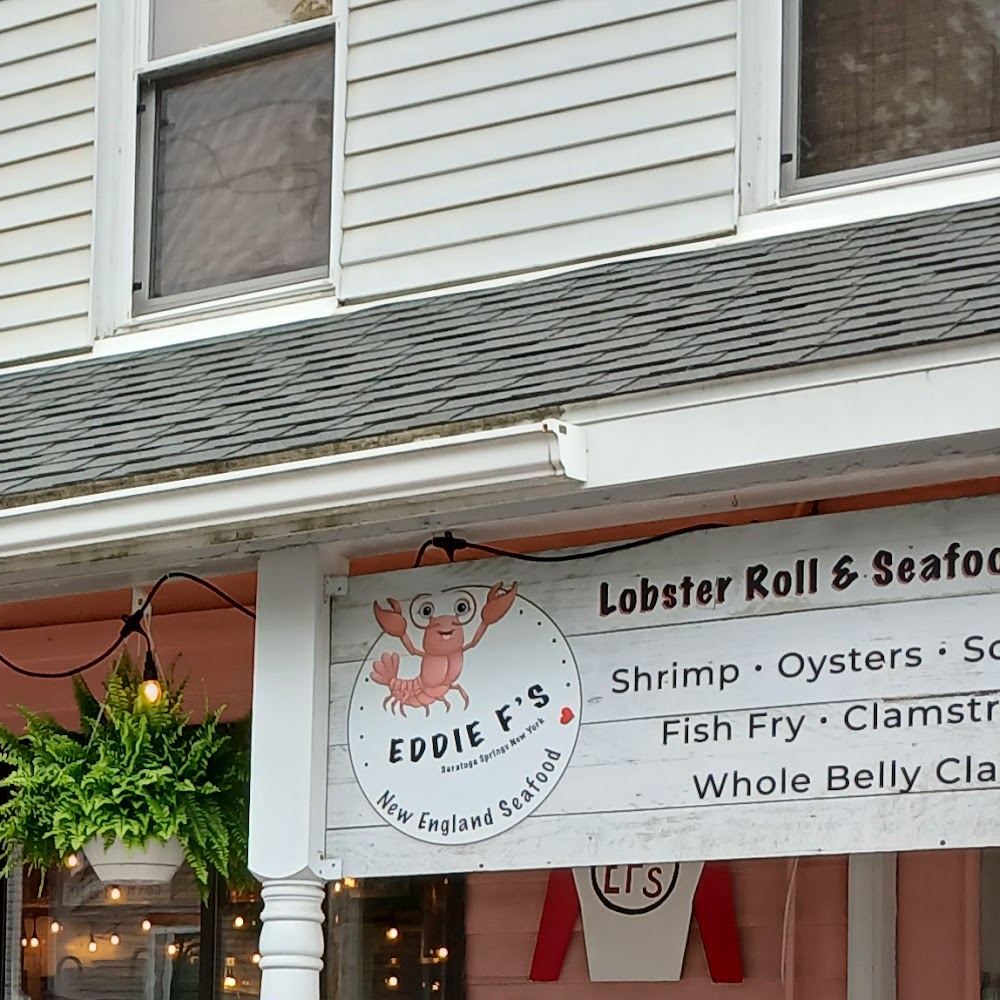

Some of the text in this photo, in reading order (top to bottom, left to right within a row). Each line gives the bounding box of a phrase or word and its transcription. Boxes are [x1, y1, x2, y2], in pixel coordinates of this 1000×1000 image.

[599, 575, 734, 617] Lobster
[744, 558, 819, 601] Roll
[831, 554, 859, 591] &
[611, 662, 741, 694] Shrimp
[777, 645, 923, 683] Oysters
[389, 720, 485, 764] EDDIE
[440, 717, 546, 774] Saratoga Springs New York
[661, 698, 1000, 746] Fish Fry Clamstr
[376, 747, 563, 837] New England Seafood
[692, 754, 997, 801] Whole Belly Cla
